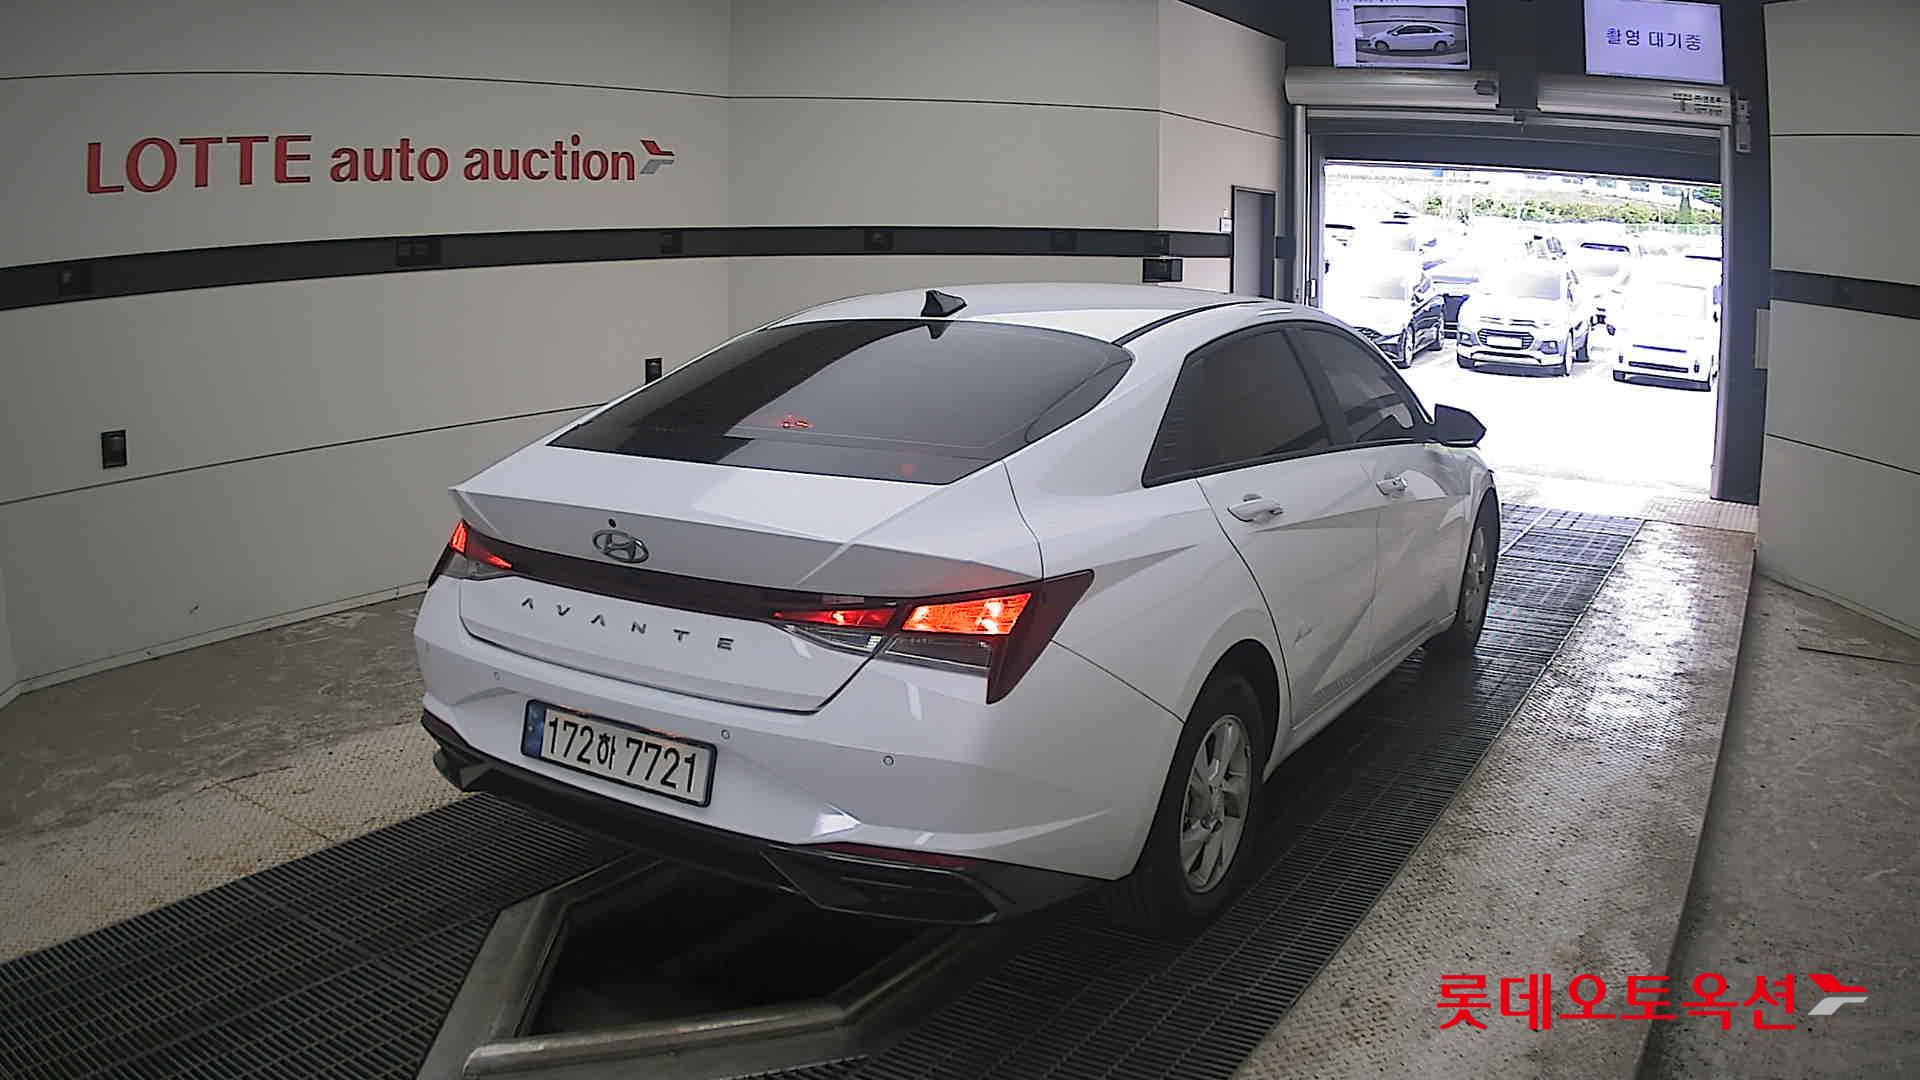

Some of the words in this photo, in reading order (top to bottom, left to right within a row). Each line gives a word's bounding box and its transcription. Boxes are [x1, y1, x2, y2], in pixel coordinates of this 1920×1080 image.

[1606, 27, 1641, 47] 촬영
[1648, 31, 1702, 51] 대기중
[87, 135, 312, 194] LOTTE
[329, 138, 449, 182] auto
[463, 133, 637, 182] auction
[521, 597, 734, 651] AVANTE
[548, 716, 617, 771] 172하
[626, 736, 697, 793] 7721
